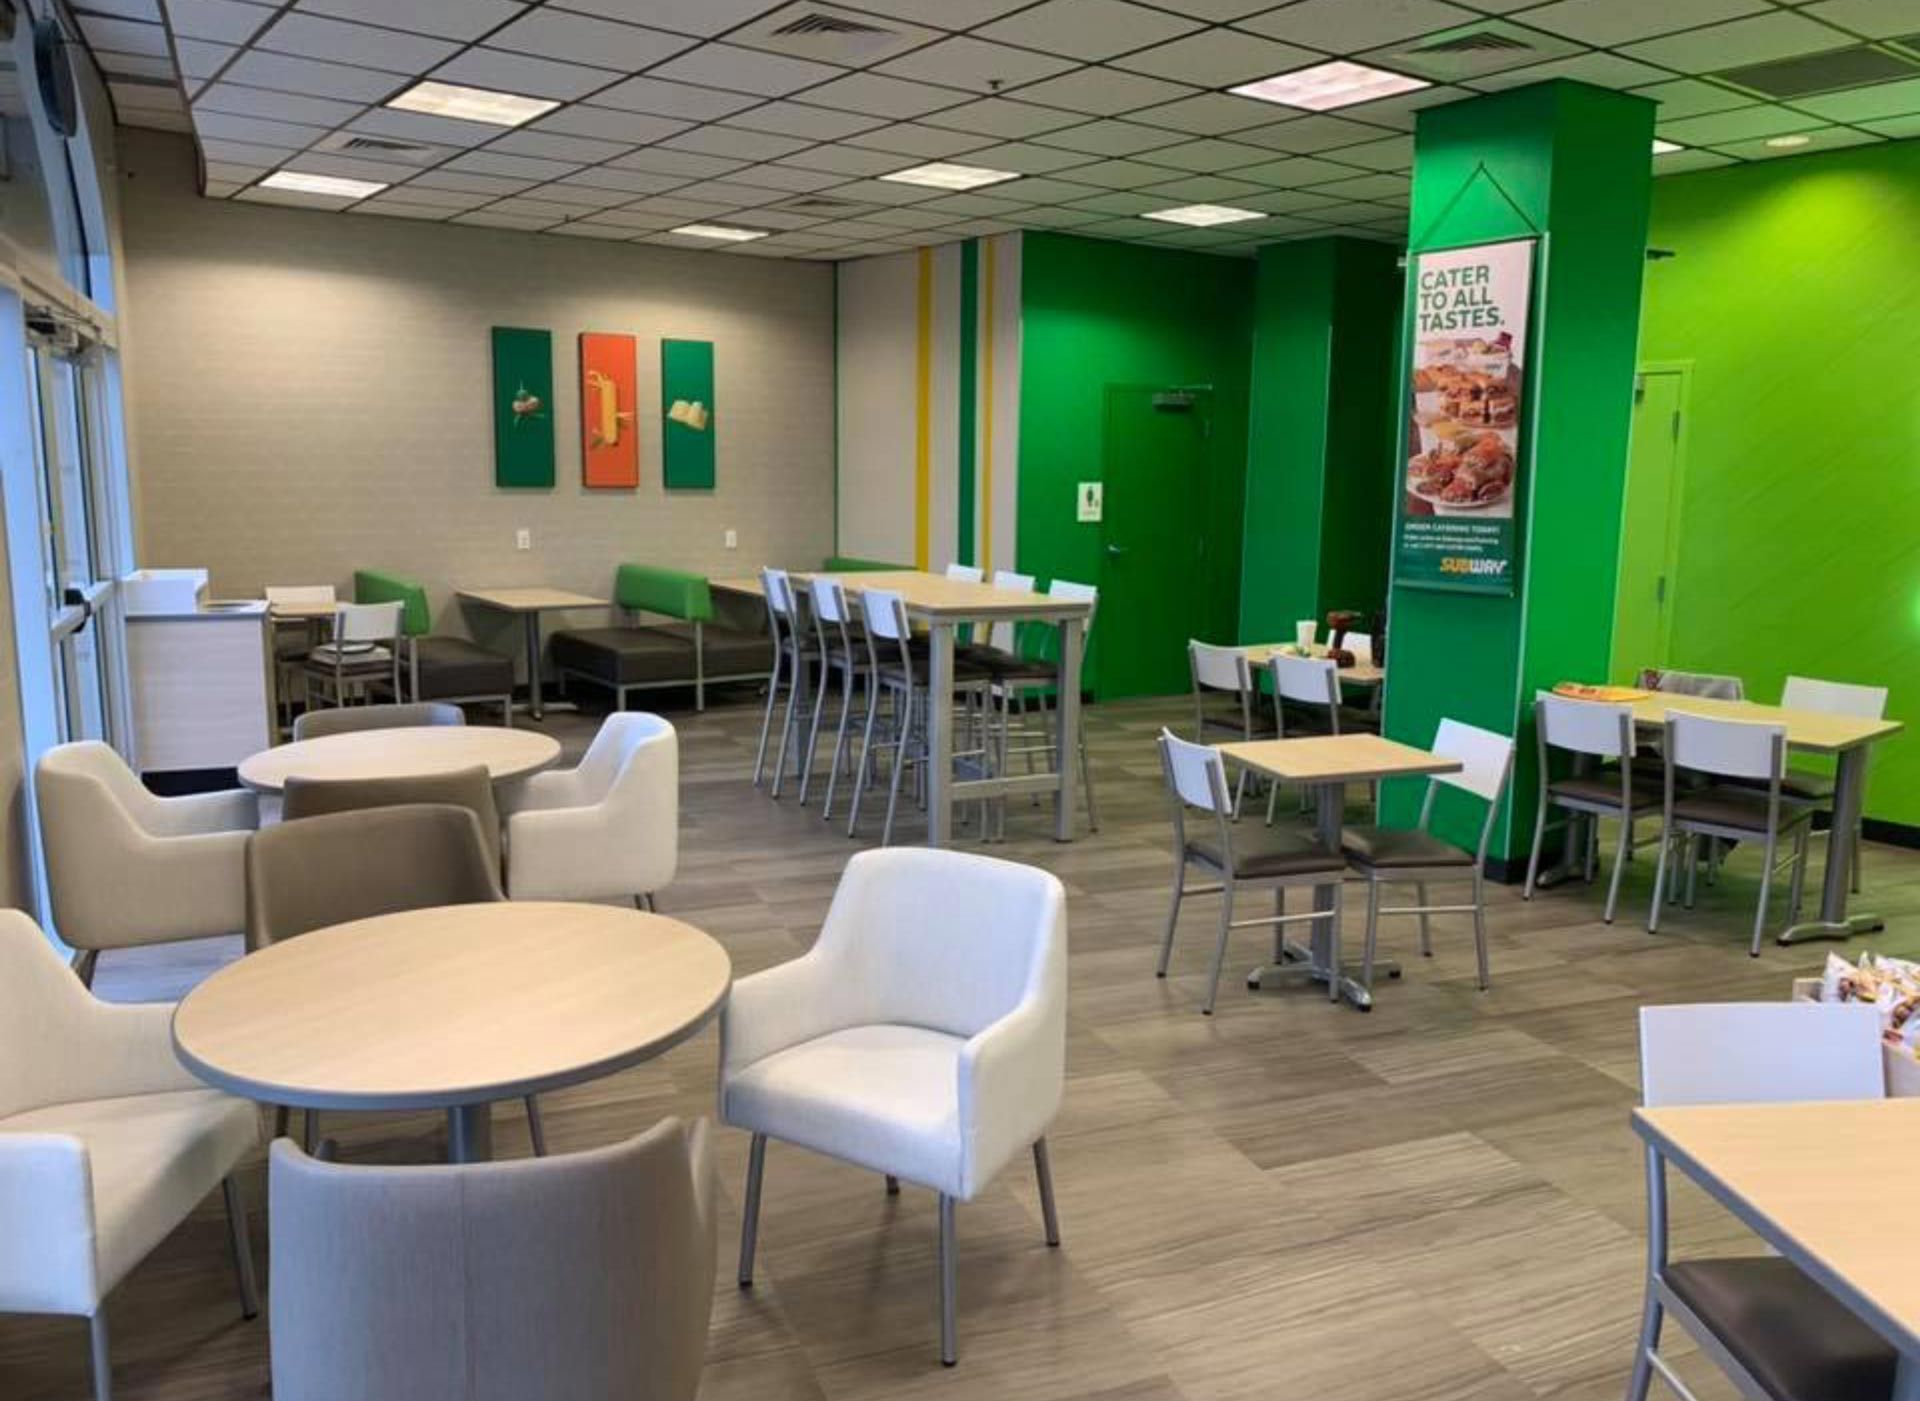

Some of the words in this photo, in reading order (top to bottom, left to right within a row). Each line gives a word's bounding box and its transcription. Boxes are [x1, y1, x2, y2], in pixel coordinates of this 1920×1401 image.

[1421, 265, 1489, 290] CATER
[1420, 291, 1447, 310] TO
[1453, 286, 1493, 307] ALL
[1419, 306, 1506, 332] TASTES.
[1440, 557, 1509, 575] SUBWAY
